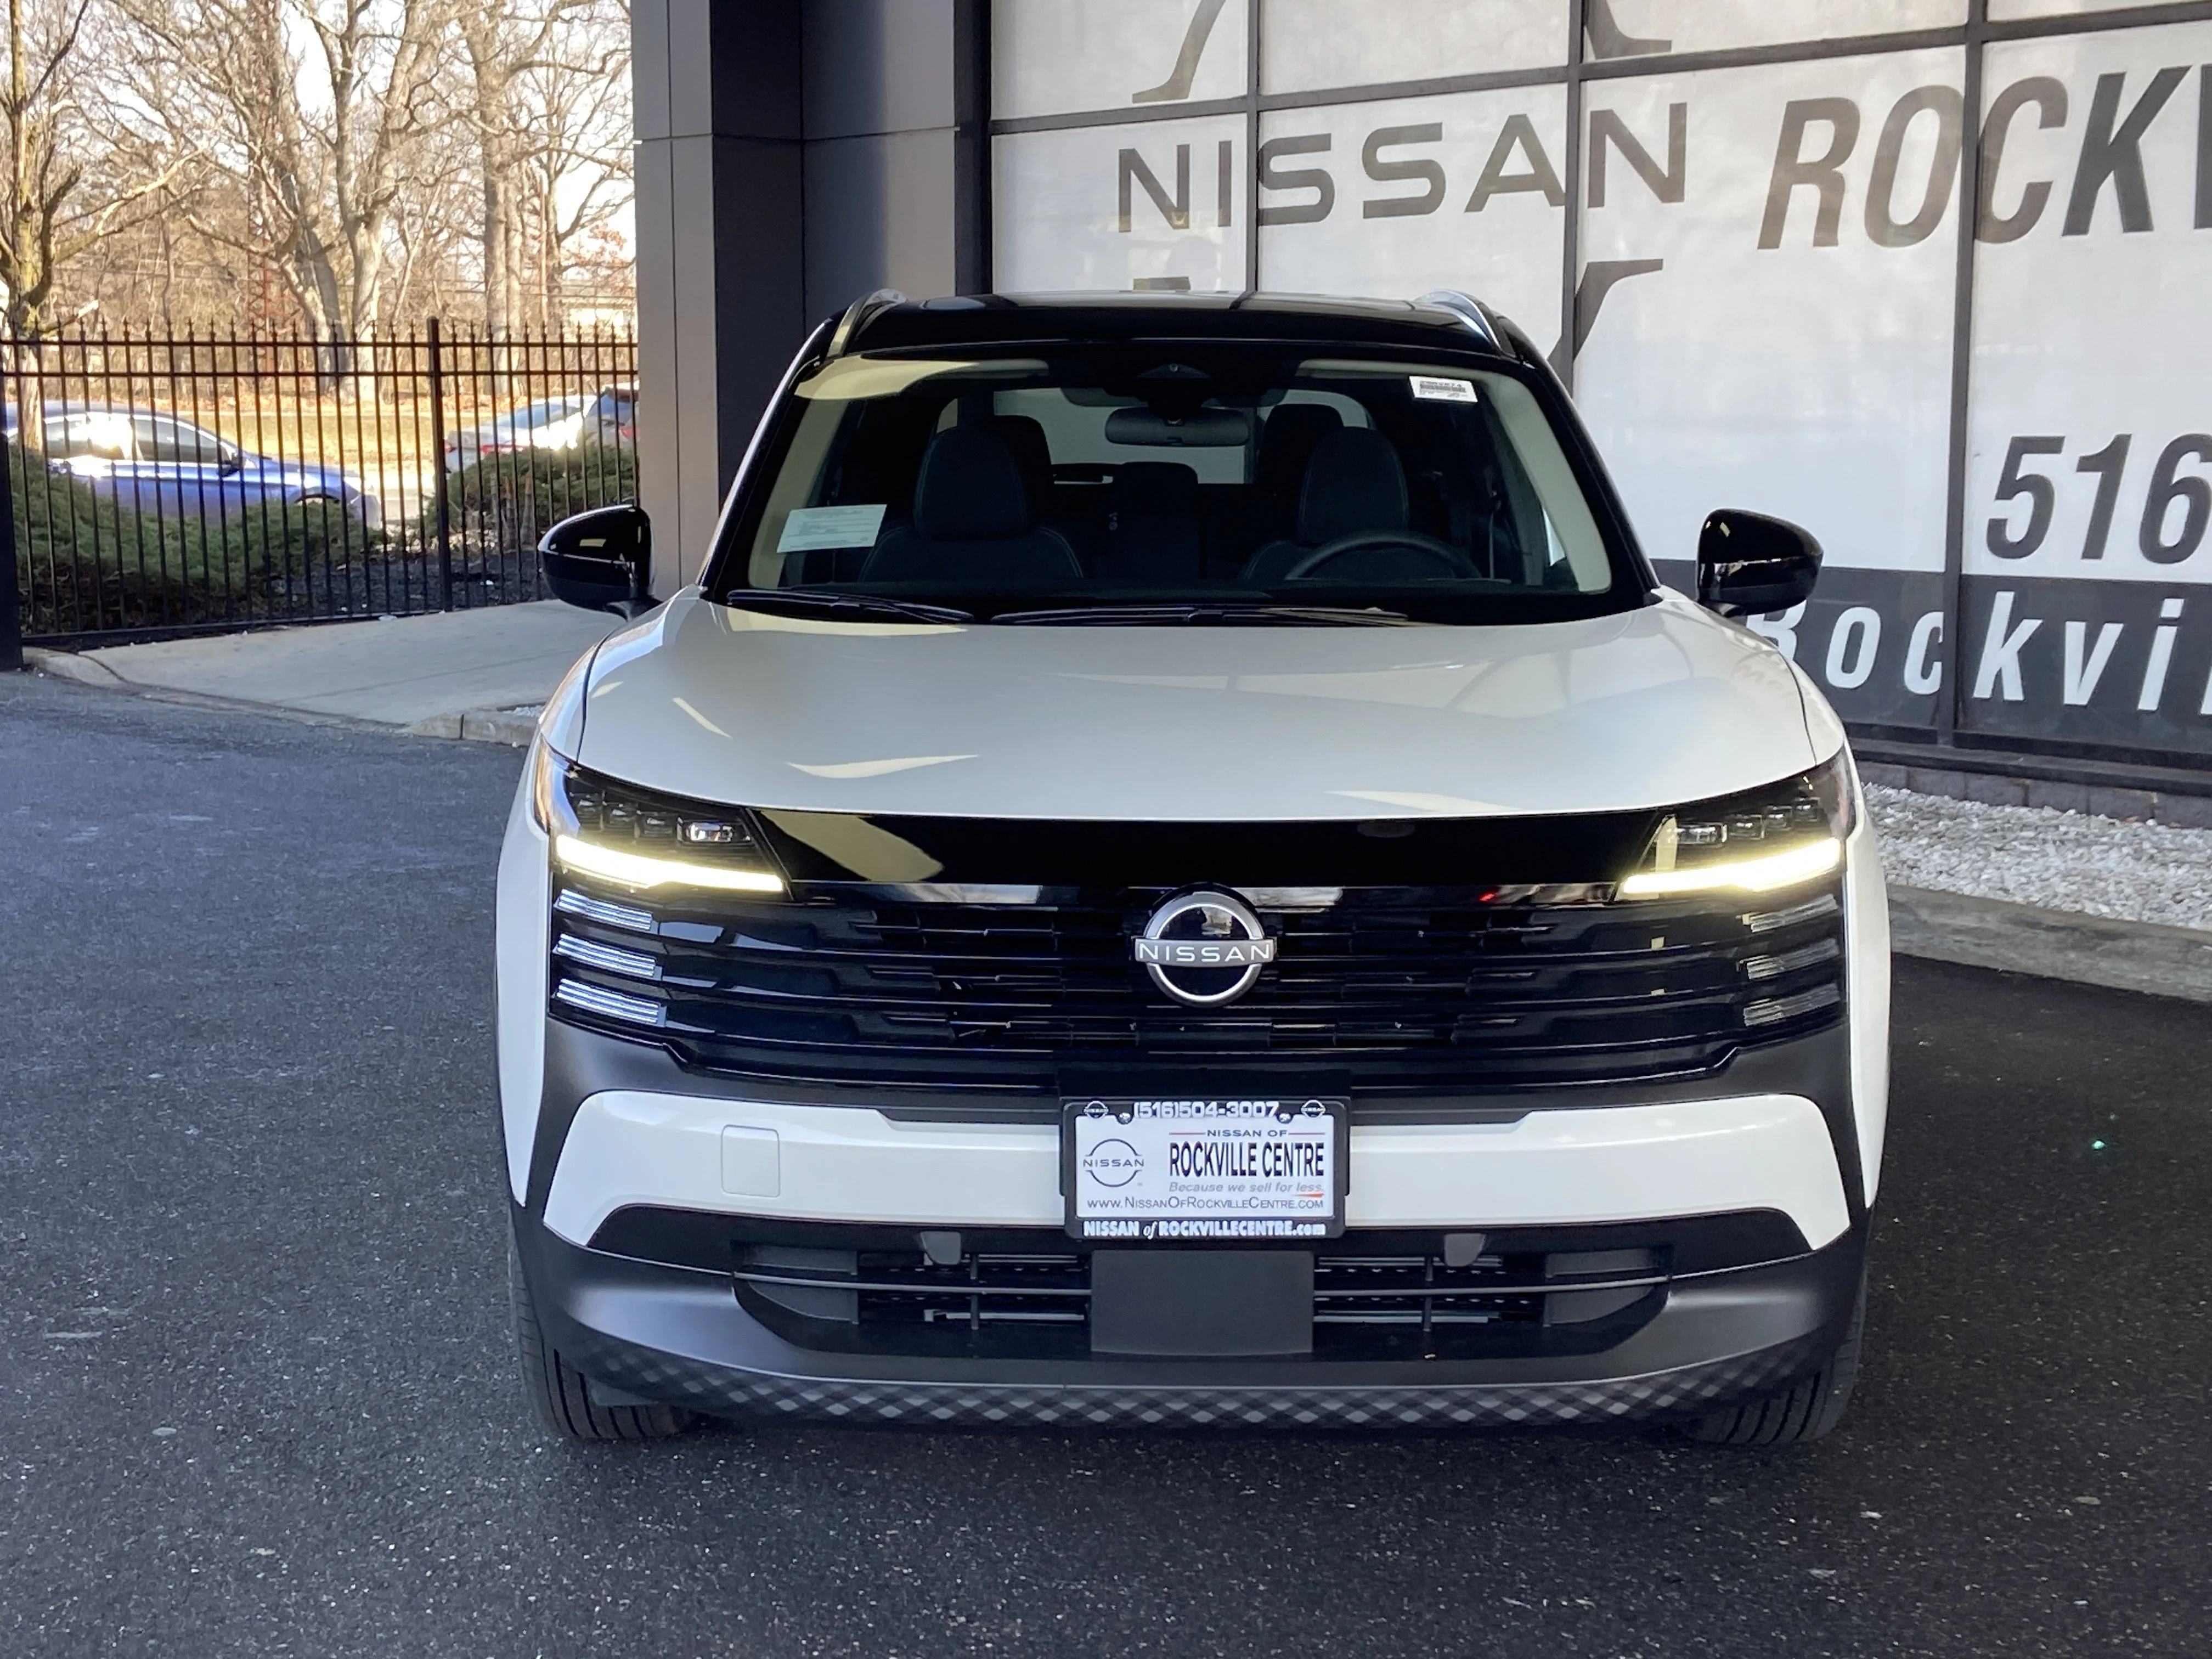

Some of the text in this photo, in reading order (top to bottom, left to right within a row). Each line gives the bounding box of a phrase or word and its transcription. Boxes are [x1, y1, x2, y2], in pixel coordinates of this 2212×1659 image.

[1757, 64, 2212, 250] ROCK
[1118, 103, 1688, 233] NISSAN
[1986, 433, 2212, 564] 516
[1139, 943, 1269, 962] NISSAN
[1133, 1101, 1279, 1119] (516)504-3007
[1207, 1129, 1288, 1137] NISSAN OF
[1083, 1159, 1145, 1167] NISSAN
[1170, 1142, 1324, 1177] ROCKVILLE CENTRE
[1169, 1182, 1223, 1192] Because
[1249, 1182, 1272, 1192] sell
[1276, 1181, 1294, 1192] for
[1084, 1220, 1326, 1240] NISSAN of ROCKVILLECENTRE.com
